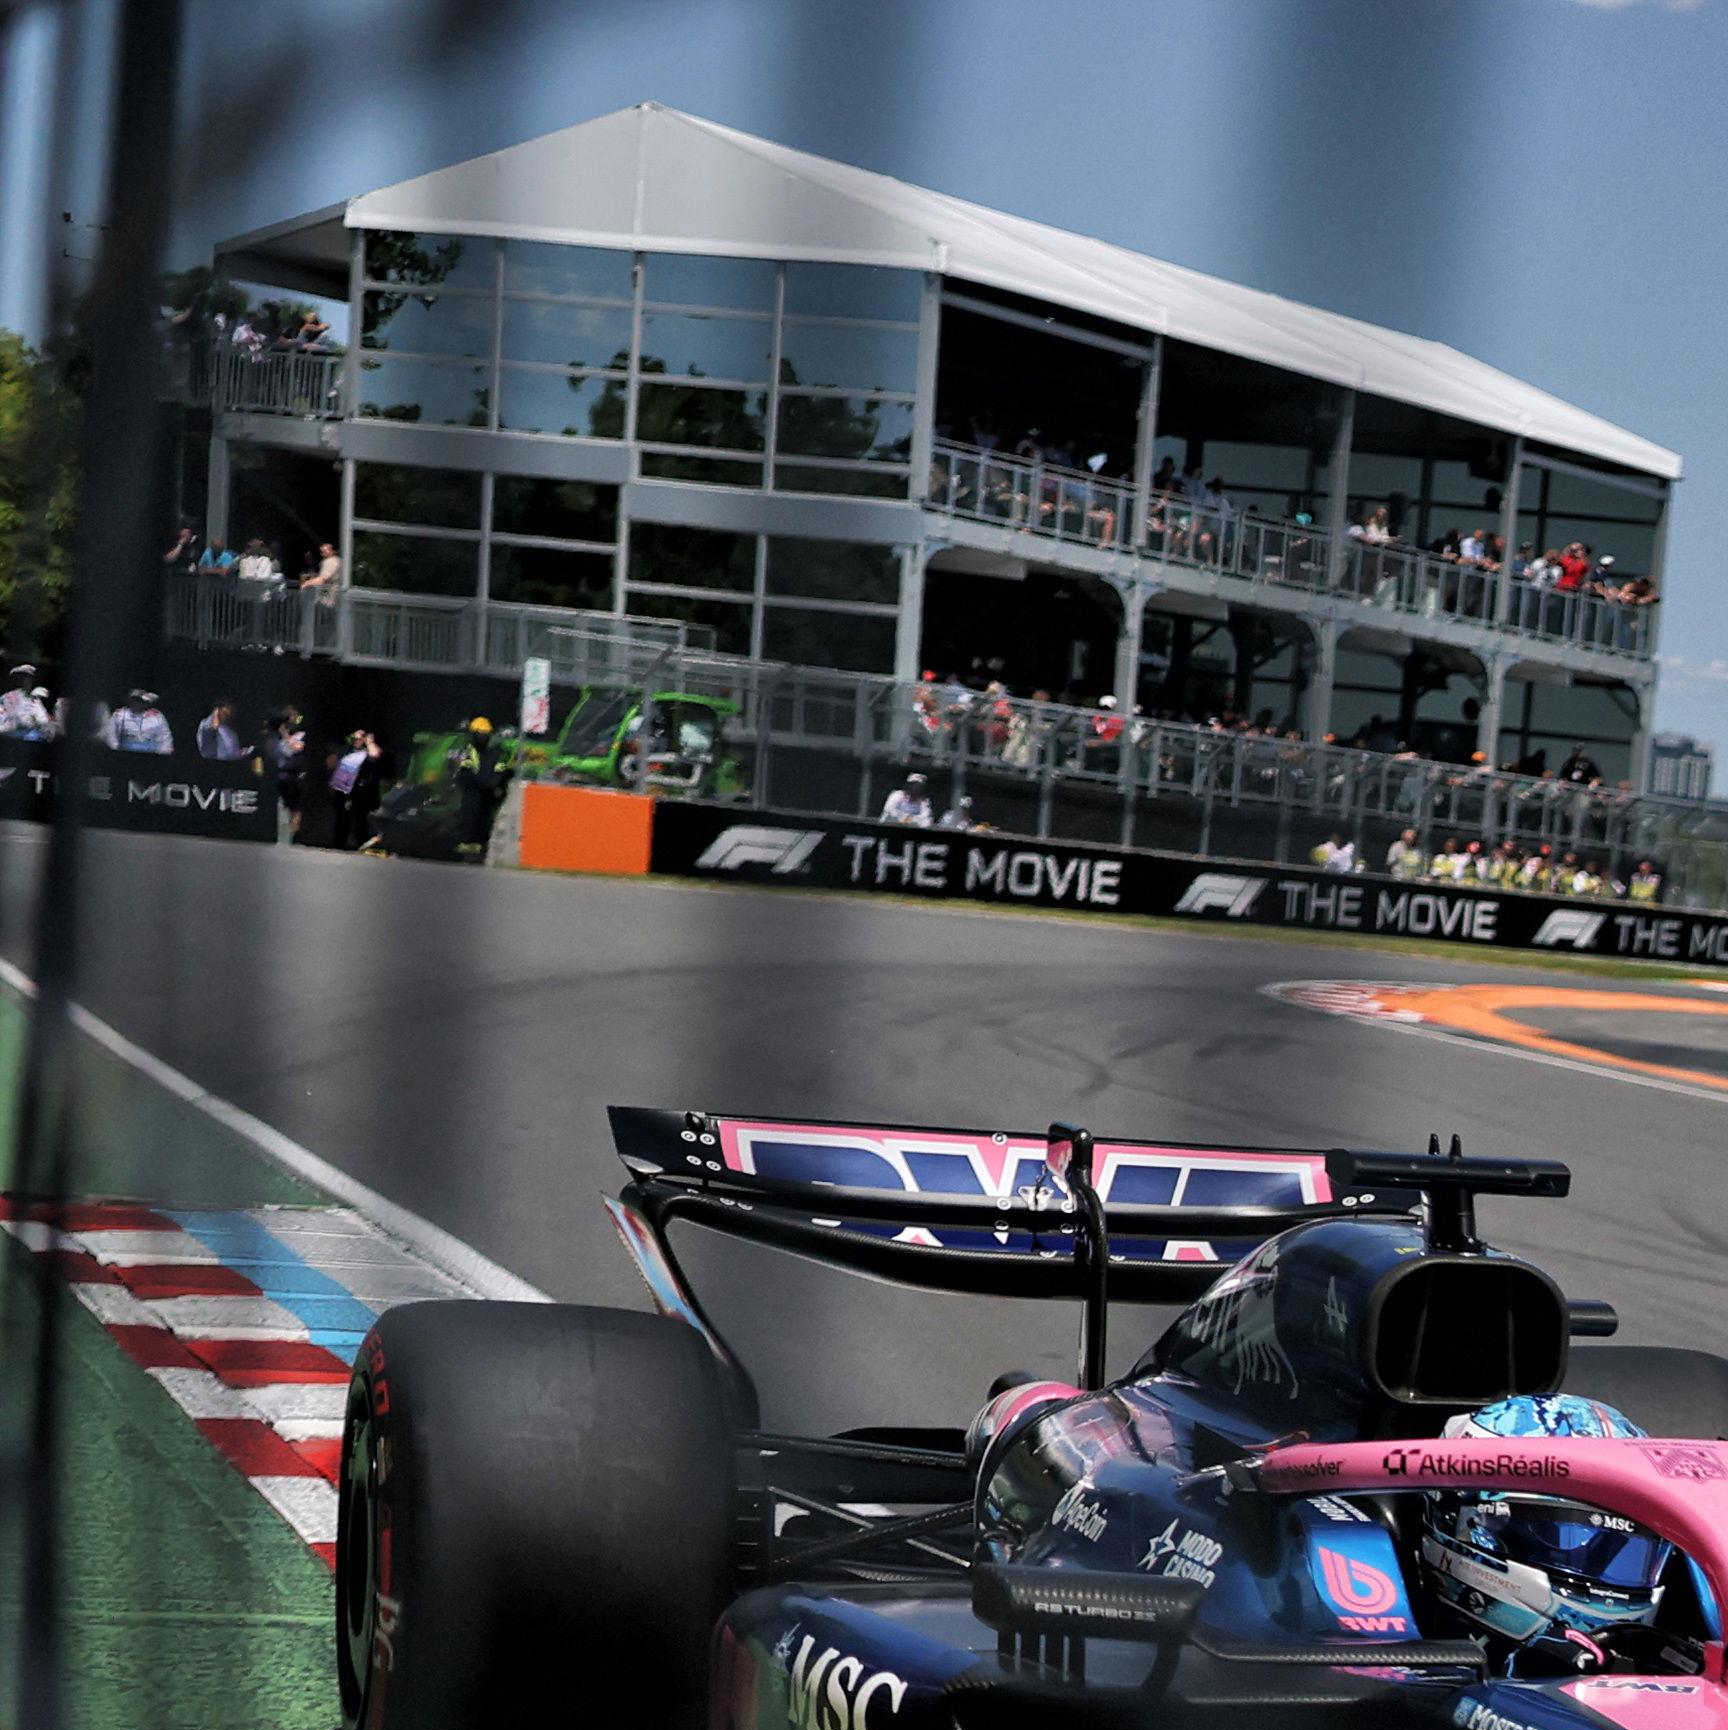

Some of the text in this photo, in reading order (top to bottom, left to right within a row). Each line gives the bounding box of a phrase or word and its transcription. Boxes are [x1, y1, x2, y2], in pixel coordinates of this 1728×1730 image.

[27, 769, 112, 800] TE
[128, 780, 259, 813] MOVIE
[842, 836, 947, 888] THE
[965, 848, 1121, 905] MOVIE
[1277, 880, 1363, 927] THE
[1375, 892, 1498, 941] MOVIE
[1614, 914, 1680, 957] THE
[1418, 1453, 1570, 1478] AtkinsRéalis
[1062, 1492, 1108, 1543] ApeCoin
[1603, 1515, 1635, 1532] MSC
[1176, 1529, 1224, 1567] MODO
[1163, 1554, 1216, 1589] CASINO
